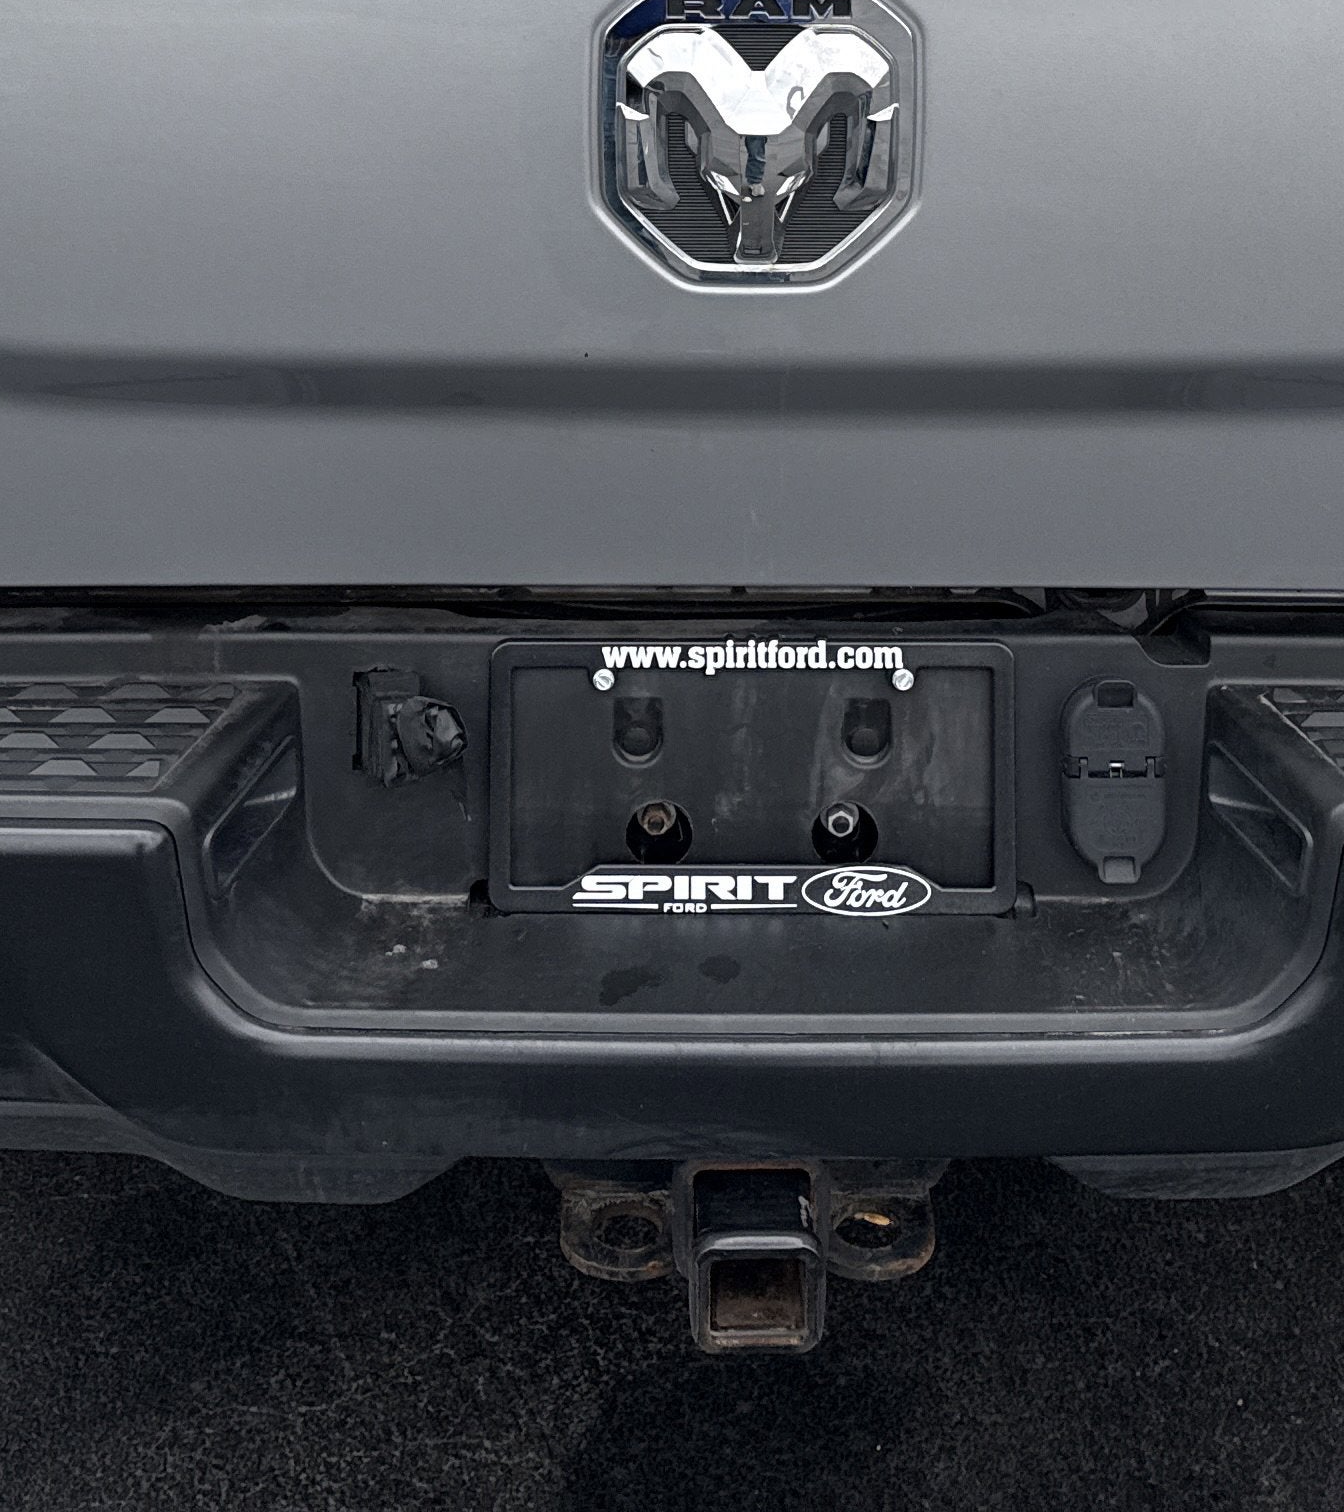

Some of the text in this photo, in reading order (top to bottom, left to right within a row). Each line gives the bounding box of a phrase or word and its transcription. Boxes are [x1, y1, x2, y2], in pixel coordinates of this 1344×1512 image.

[601, 640, 904, 676] www.spiritford.com
[572, 871, 908, 909] SPIRIT Ford
[663, 902, 708, 913] FORD
